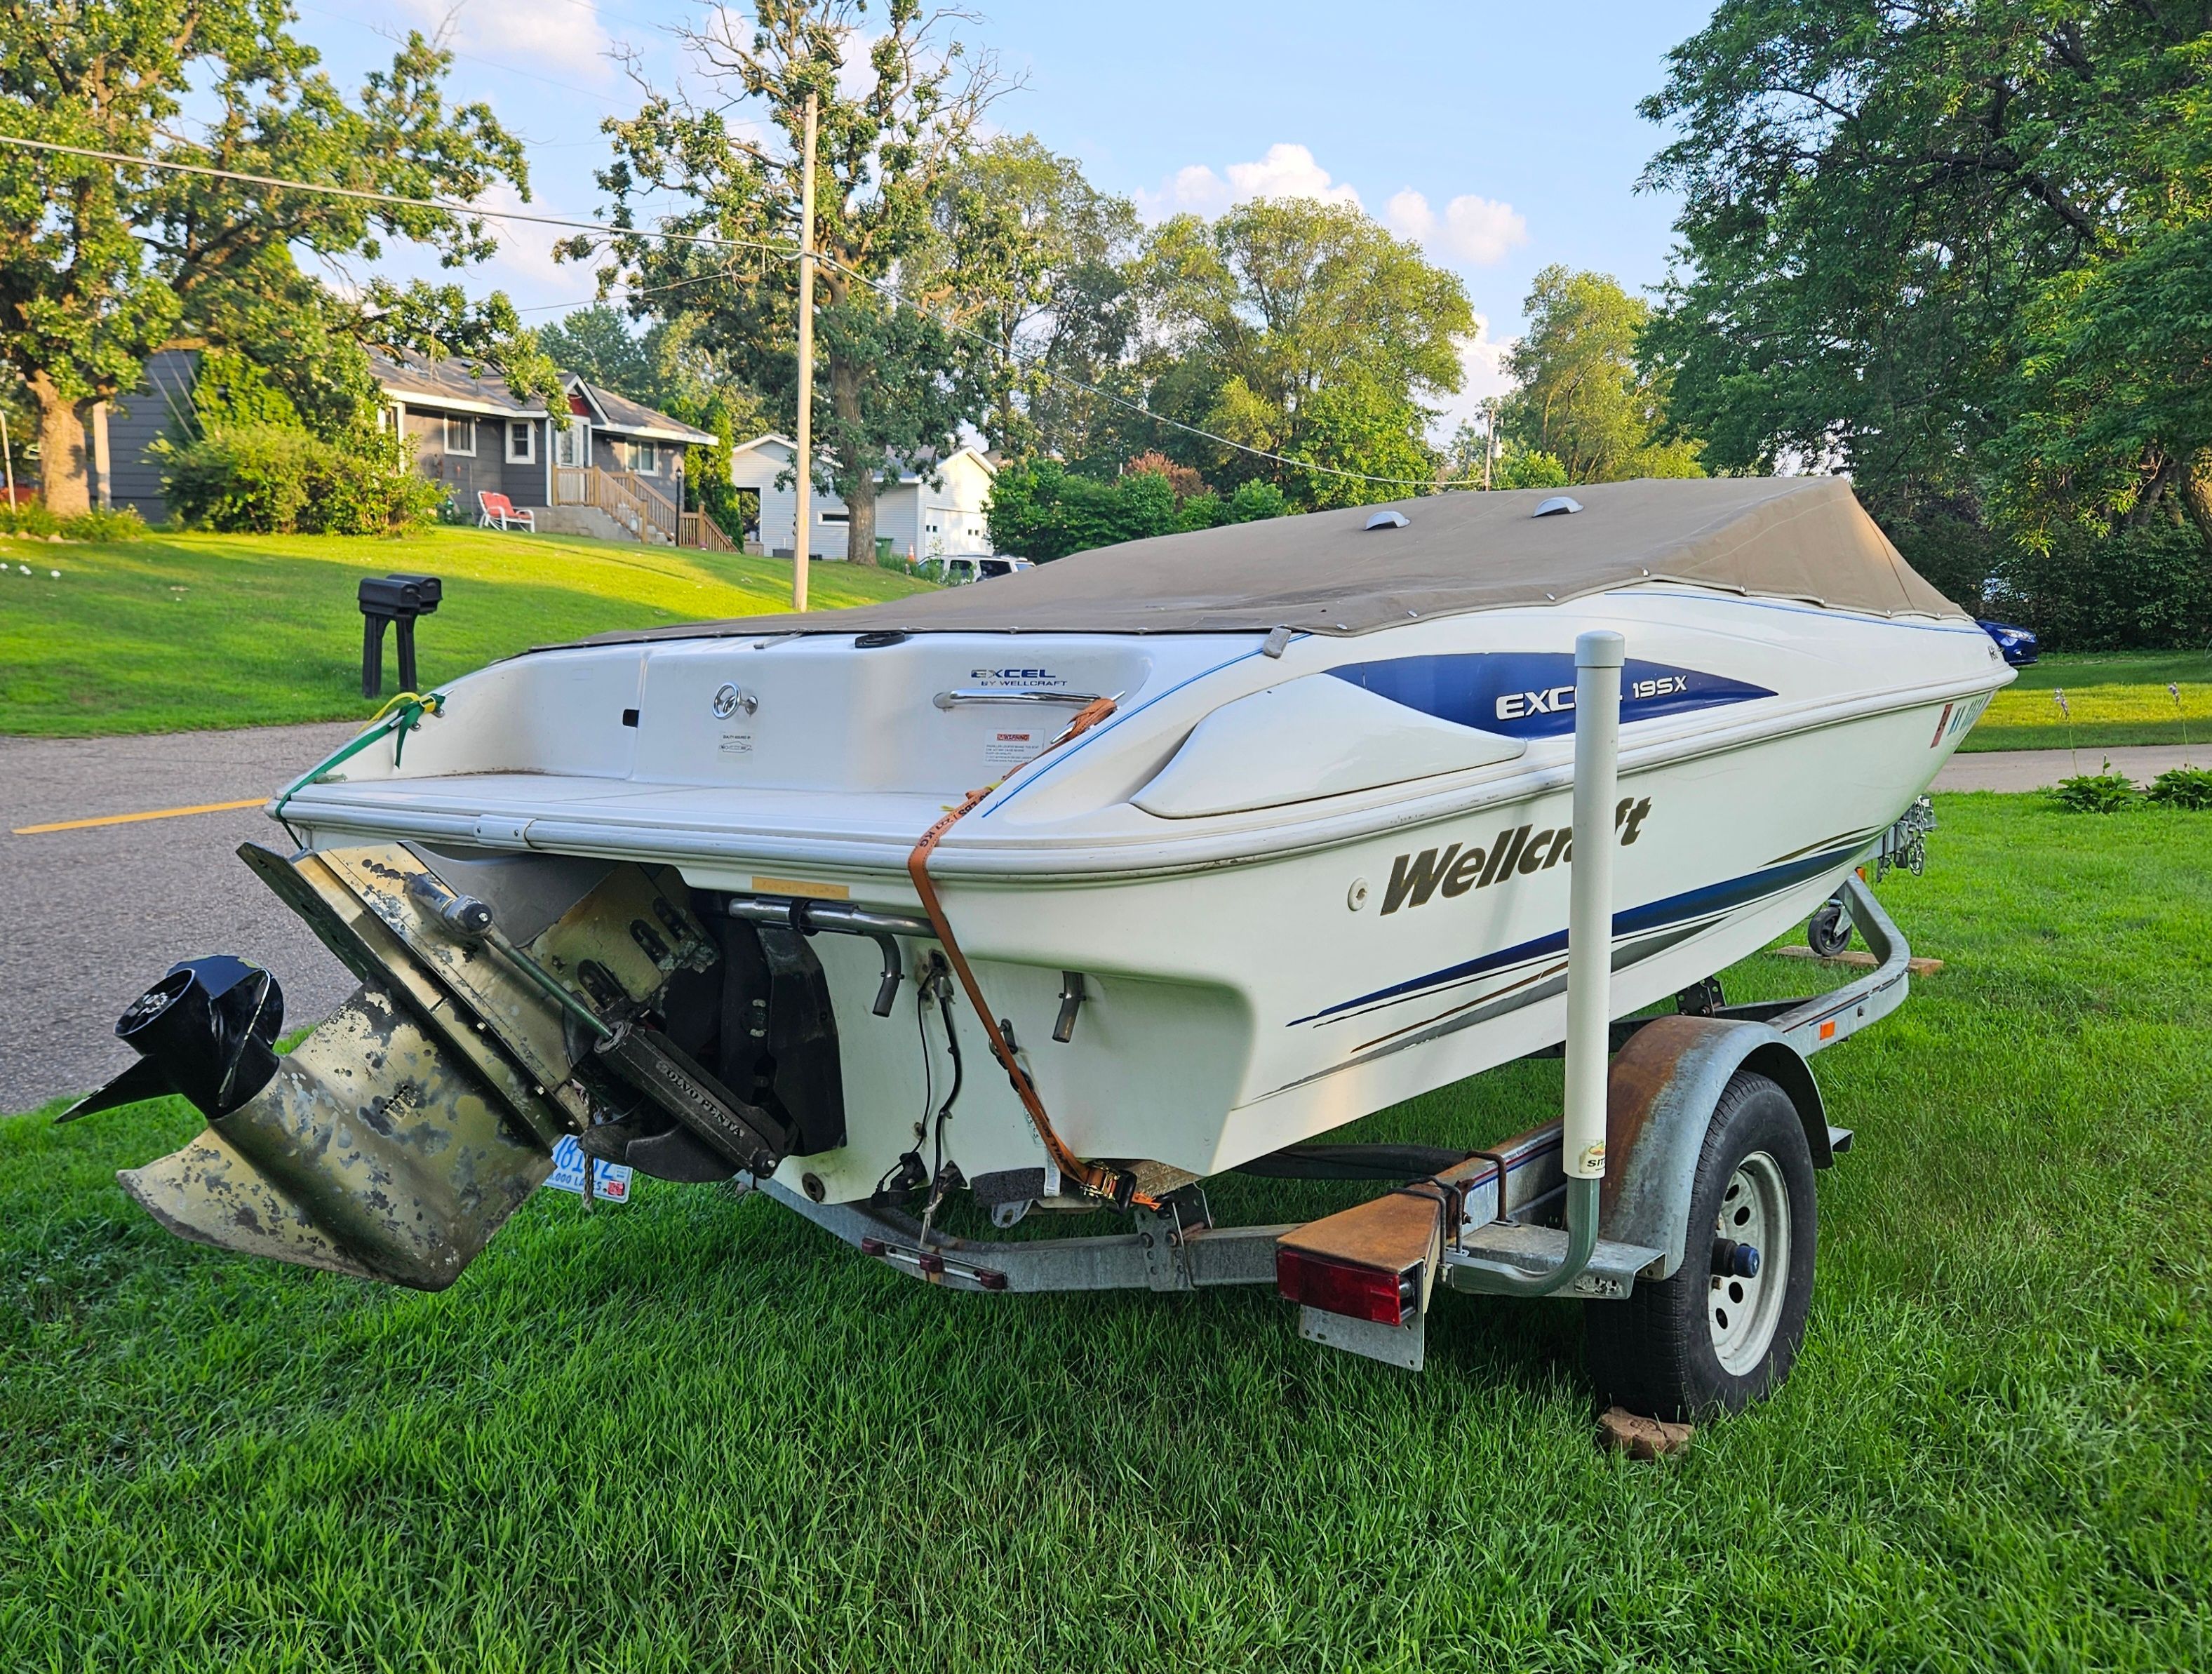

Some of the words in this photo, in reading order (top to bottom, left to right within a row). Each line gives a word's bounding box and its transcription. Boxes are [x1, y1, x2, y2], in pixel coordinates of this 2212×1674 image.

[971, 669, 1056, 678] EXCEL
[1496, 685, 1623, 721] EXC
[919, 831, 935, 847] KG
[1380, 796, 1652, 916] Wellcrft
[700, 1098, 745, 1139] PENTA
[574, 1176, 602, 1191] LAS
